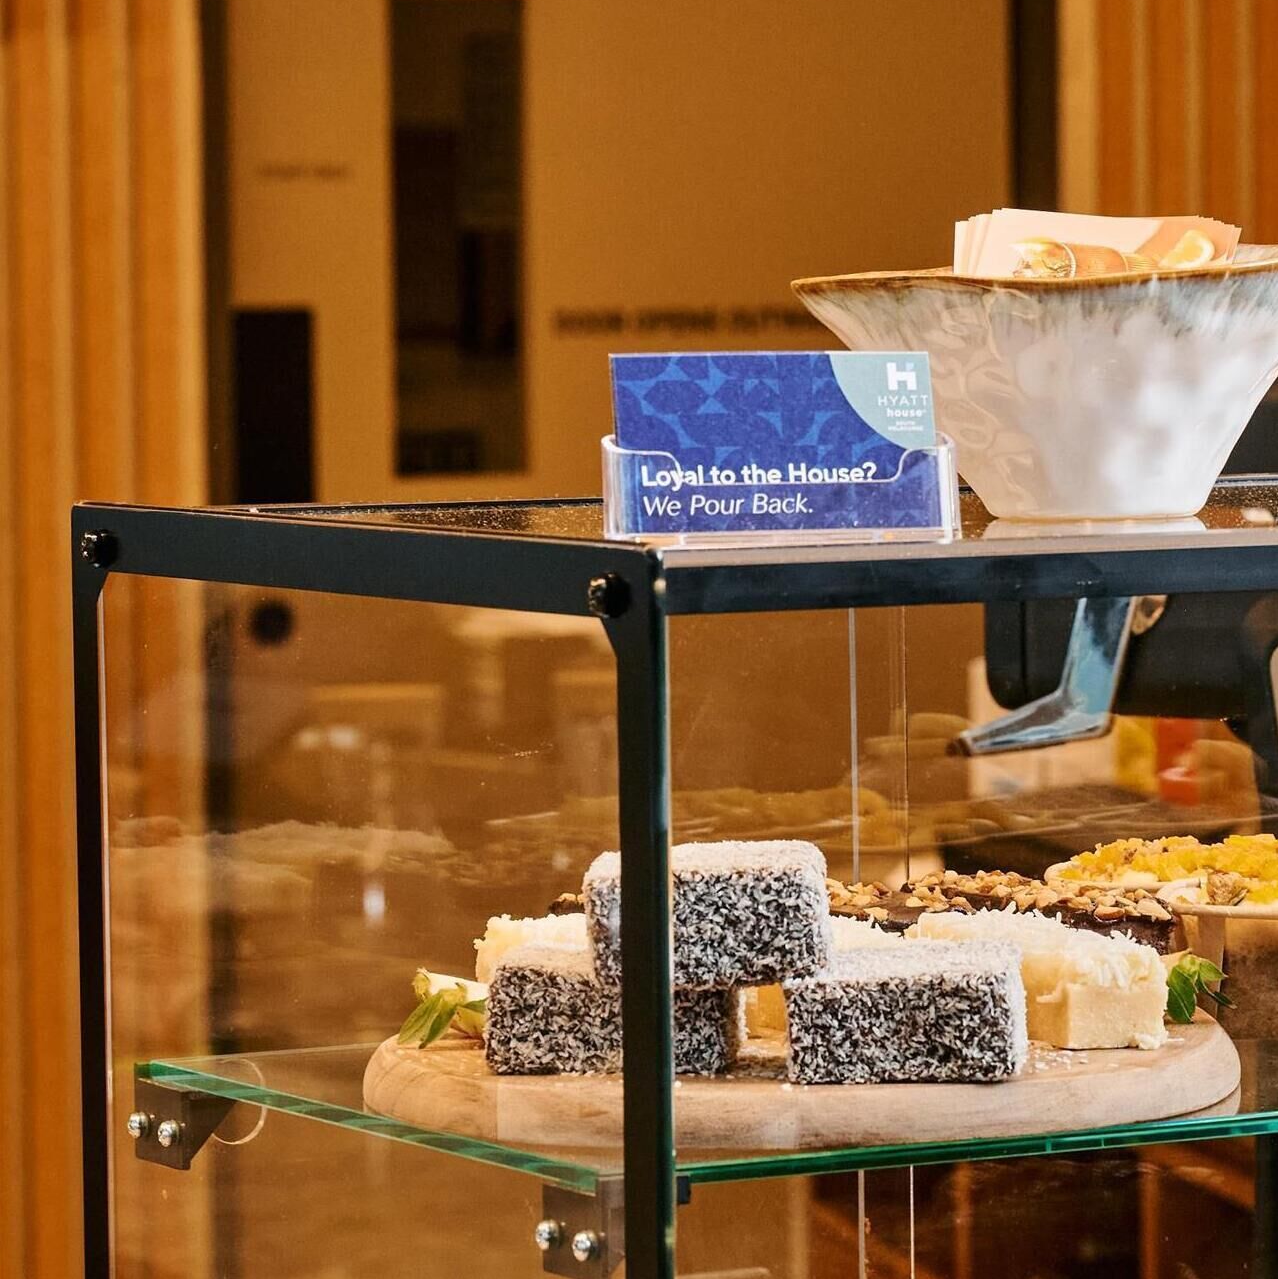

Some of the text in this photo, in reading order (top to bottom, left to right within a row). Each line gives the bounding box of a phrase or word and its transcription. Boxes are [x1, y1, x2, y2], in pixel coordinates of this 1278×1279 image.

[877, 394, 929, 406] HYATT
[887, 408, 922, 417] house
[641, 462, 877, 491] Loyal to the House?
[643, 493, 814, 517] We Pour Back.
